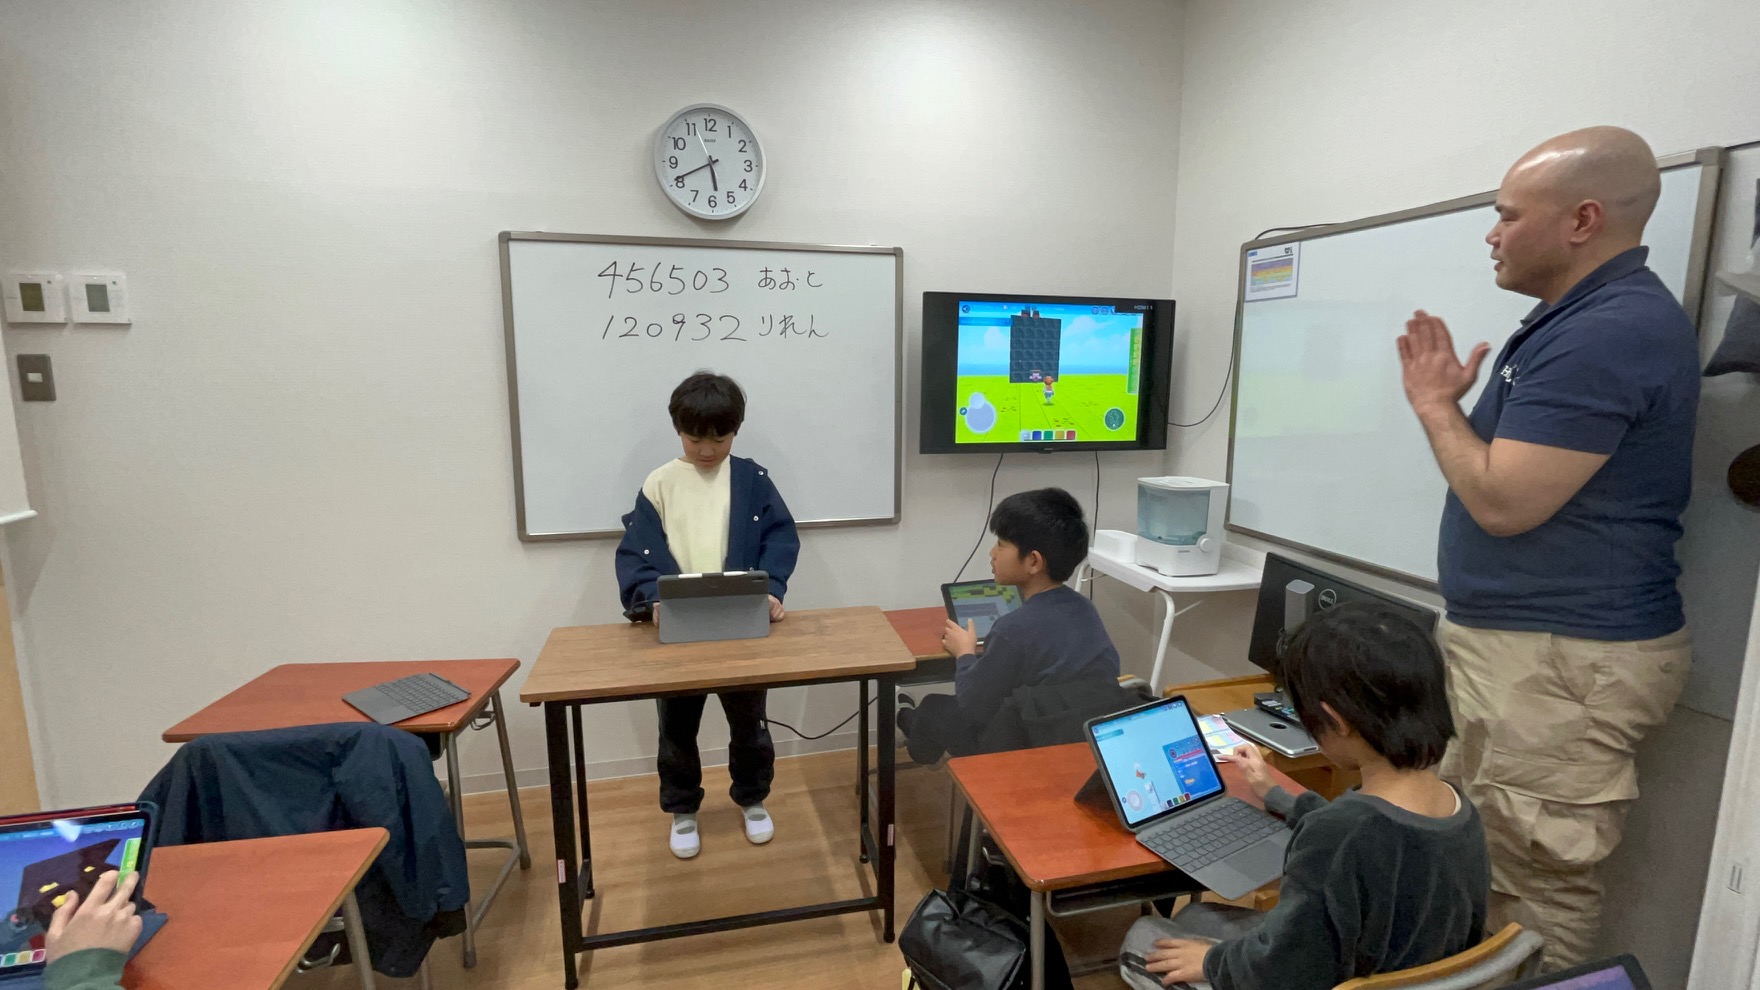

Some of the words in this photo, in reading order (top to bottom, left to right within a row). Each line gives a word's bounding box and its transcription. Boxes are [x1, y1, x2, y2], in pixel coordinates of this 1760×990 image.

[685, 122, 697, 136] 11
[703, 118, 717, 132] 12
[727, 125, 732, 139] 1
[672, 136, 687, 151] 10
[738, 139, 748, 153] 2
[668, 155, 679, 169] 9
[743, 159, 753, 173] 3
[675, 175, 685, 189] 8
[738, 178, 748, 192] 4
[690, 189, 699, 203] 7
[708, 194, 718, 209] 6
[726, 191, 736, 204] 5
[597, 260, 730, 299] 456503
[757, 266, 823, 291] あおと
[602, 312, 747, 342] 120932
[758, 314, 829, 339] りれん
